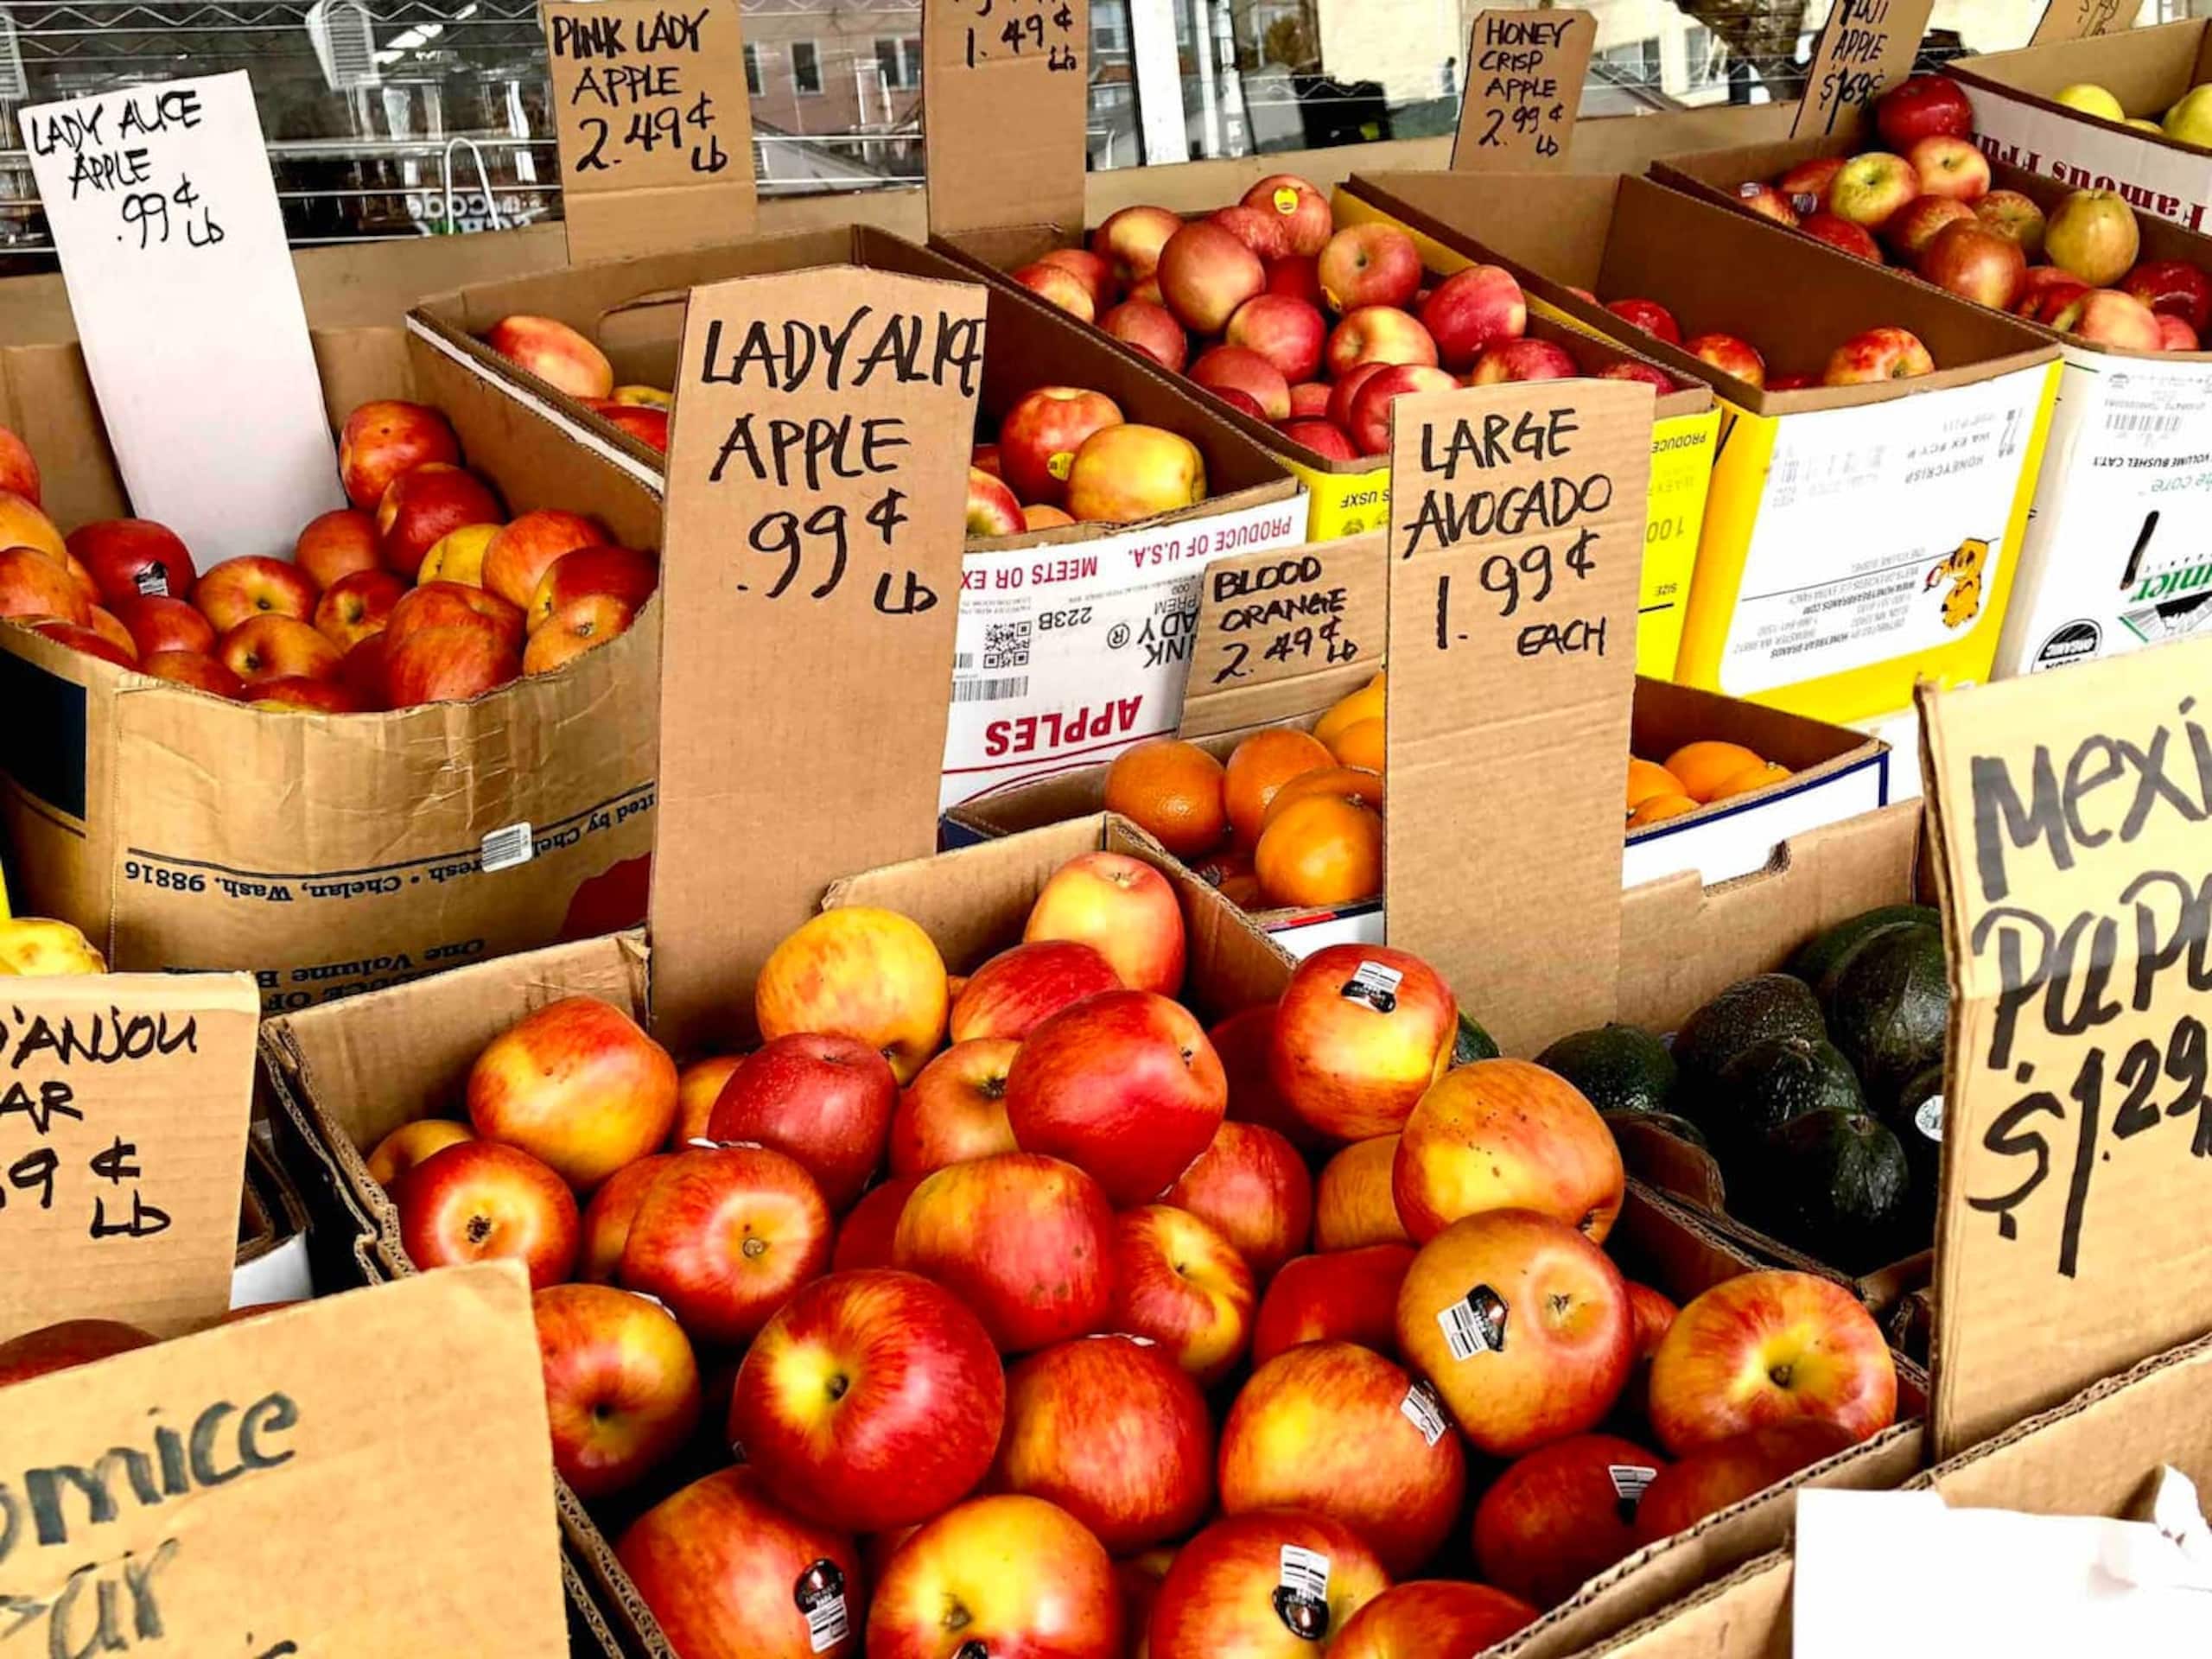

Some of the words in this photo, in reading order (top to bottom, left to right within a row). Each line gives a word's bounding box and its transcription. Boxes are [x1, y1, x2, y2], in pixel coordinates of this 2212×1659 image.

[552, 16, 626, 59] PINK
[636, 8, 709, 53] LADY
[1486, 17, 1574, 48] HONEY
[1831, 29, 1888, 64] APPLE
[1478, 50, 1543, 74] CRISP
[571, 64, 682, 107] APPLE
[1484, 77, 1556, 104] APPLE
[32, 103, 103, 156] LADY
[68, 149, 150, 200] APPLE
[2052, 161, 2207, 232] Famous
[701, 305, 873, 392] LADY
[709, 413, 911, 491] APPLE
[1421, 408, 1579, 480] LARGE
[1652, 432, 1706, 454] PRODUCE
[2128, 456, 2171, 468] BUSHEL
[1402, 474, 1612, 560] AVOCADO
[1186, 535, 1209, 557] OF
[1216, 516, 1292, 551] PRODUCE
[1128, 540, 1179, 568] U.S.A.
[995, 566, 1023, 589] OR
[1032, 556, 1097, 585] MEETS
[1214, 556, 1322, 602] BLOOD
[1039, 606, 1092, 631] 223B
[1154, 594, 1198, 615] PREM
[1219, 588, 1347, 632] ORANGE
[1517, 616, 1605, 657] EACH
[985, 695, 1143, 756] APPLES
[588, 812, 610, 833] by
[532, 825, 581, 857] Chel
[124, 861, 206, 893] 98816
[430, 858, 482, 882] resh
[214, 877, 292, 902] Wash.
[302, 876, 402, 899] Chelan,
[424, 938, 485, 961] One
[291, 954, 412, 982] Volume
[0, 1004, 197, 1069] 'ANJOU
